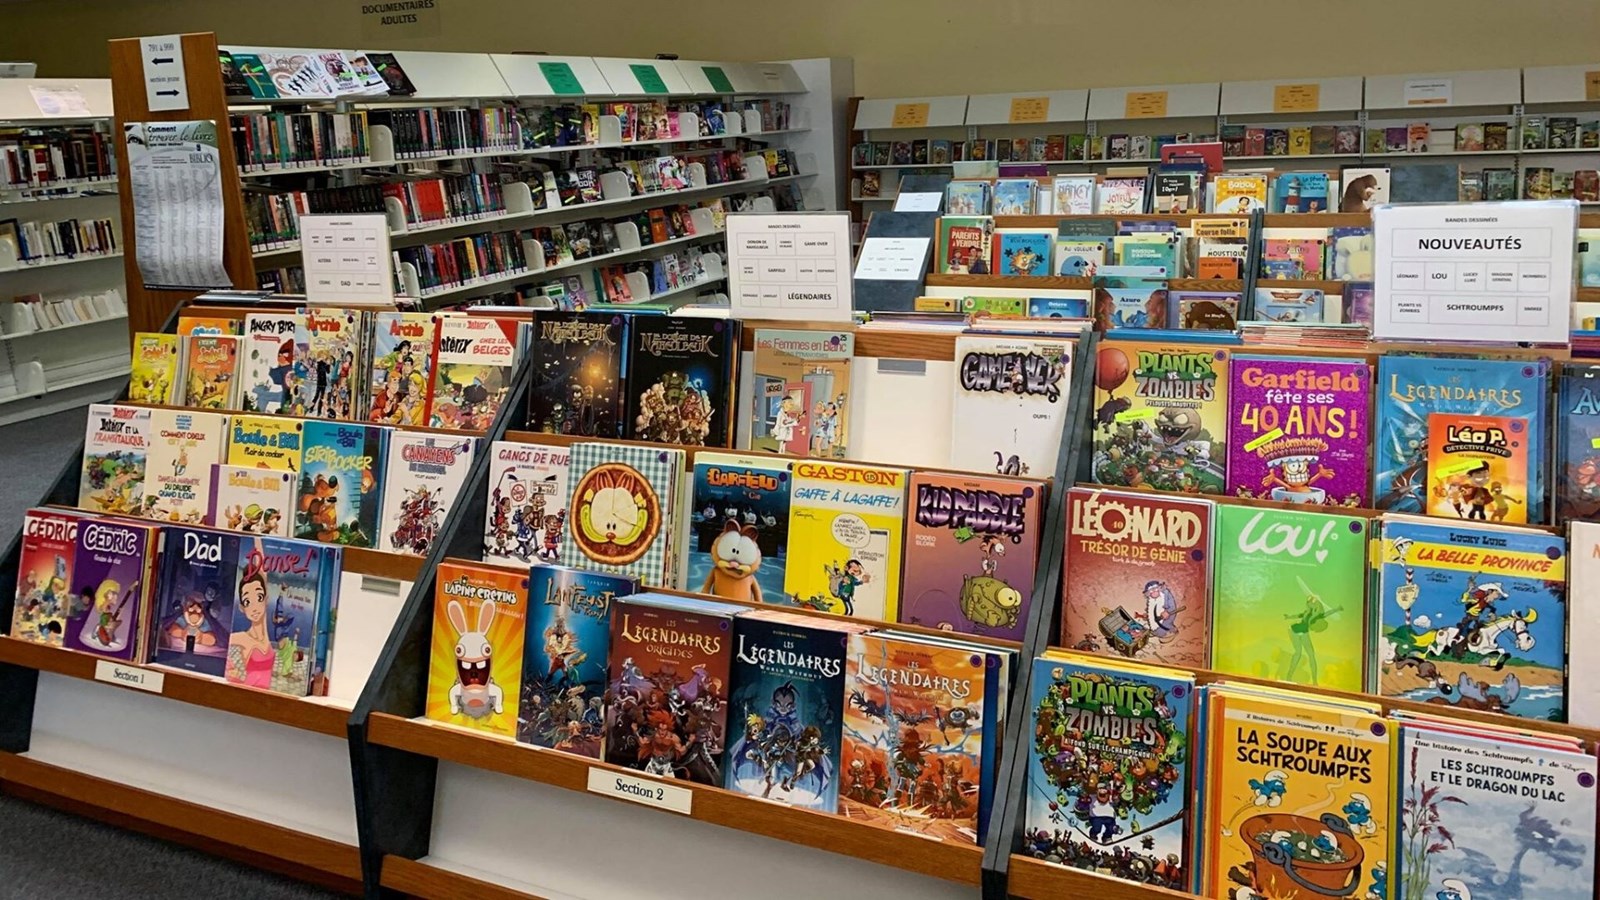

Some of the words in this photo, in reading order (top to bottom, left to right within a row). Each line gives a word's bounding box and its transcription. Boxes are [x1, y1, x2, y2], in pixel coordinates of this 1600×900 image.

[362, 0, 434, 14] DOCUMENTAIRES
[381, 14, 417, 25] ADULTES
[951, 232, 980, 240] PARENTS
[956, 240, 981, 248] VENDRE
[1418, 236, 1522, 250] NOUVEAUTÉS
[788, 292, 832, 300] LÉGENDAIRES
[1446, 304, 1504, 312] SCHTROUMPFS
[250, 319, 276, 334] ANGRY
[305, 314, 341, 332] Archie
[389, 319, 424, 337] Archie
[473, 344, 511, 355] BELGES
[757, 337, 772, 348] Les
[774, 338, 810, 351] Femmes
[811, 341, 821, 351] en
[1136, 350, 1213, 375] PLANTS
[961, 352, 1013, 394] GAME
[1167, 371, 1180, 380] VS.
[1241, 367, 1360, 392] Garfield
[1135, 376, 1215, 402] ZOMBIES
[1265, 389, 1302, 404] fête
[1307, 392, 1335, 404] ses
[1241, 403, 1279, 433] 40
[1285, 404, 1346, 438] ANS
[1349, 409, 1358, 439] !
[125, 426, 131, 434] ET
[132, 427, 139, 435] LA
[160, 430, 186, 439] COMMENT
[1447, 425, 1486, 444] Léo
[1487, 427, 1507, 446] P.
[233, 428, 267, 447] Boule
[268, 434, 277, 447] &
[278, 432, 300, 450] Bill
[258, 448, 264, 456] de
[265, 449, 285, 459] cocker
[498, 449, 531, 463] GANGS
[533, 452, 548, 464] DE
[1446, 445, 1485, 453] DÉTECTIVE
[328, 454, 373, 470] COCKER
[229, 475, 255, 488] Boule
[797, 464, 899, 486] GASTON
[165, 483, 172, 491] DU
[173, 484, 192, 493] DRUIDE
[794, 487, 830, 501] GAFFE
[831, 488, 842, 502] À
[1071, 490, 1202, 548] LÉONARD
[184, 532, 222, 562] Dad
[1450, 532, 1480, 544] LUCKY
[1482, 535, 1507, 547] LUKE
[1080, 539, 1129, 556] TRÉSOR
[1132, 546, 1147, 559] DE
[1417, 548, 1434, 560] LA
[1436, 549, 1478, 565] BELLE
[1481, 554, 1553, 573] PROVINCE
[443, 582, 475, 598] LAPINS
[544, 576, 615, 616] LANFEUST
[621, 613, 721, 655] LÉGENDAIRES
[783, 641, 794, 649] LES
[736, 633, 840, 678] LÉGENDAIRES
[113, 668, 139, 683] Section
[141, 674, 145, 684] 1
[1067, 675, 1154, 711] PLANTS
[1102, 705, 1117, 715] VS.
[1065, 706, 1157, 746] ZOMBIES
[1070, 739, 1086, 748] FOND
[1088, 742, 1100, 750] SUR
[1237, 727, 1259, 746] LA
[1267, 731, 1328, 757] SOUPE
[1333, 744, 1372, 766] AUX
[1414, 739, 1430, 747] Une
[1432, 742, 1462, 753] histoire
[1464, 748, 1480, 756] des
[1482, 750, 1534, 765] Schtroumpfs
[1236, 746, 1372, 784] SCHTROUMPFS
[1440, 758, 1462, 771] LES
[1466, 761, 1555, 786] SCHTROUMPFS
[615, 778, 653, 799] Section
[656, 788, 664, 801] 2
[1430, 771, 1446, 783] ET
[1449, 774, 1462, 786] LE
[1466, 776, 1517, 796] DRAGON
[1522, 785, 1539, 798] DU
[1542, 789, 1566, 803] LAC
